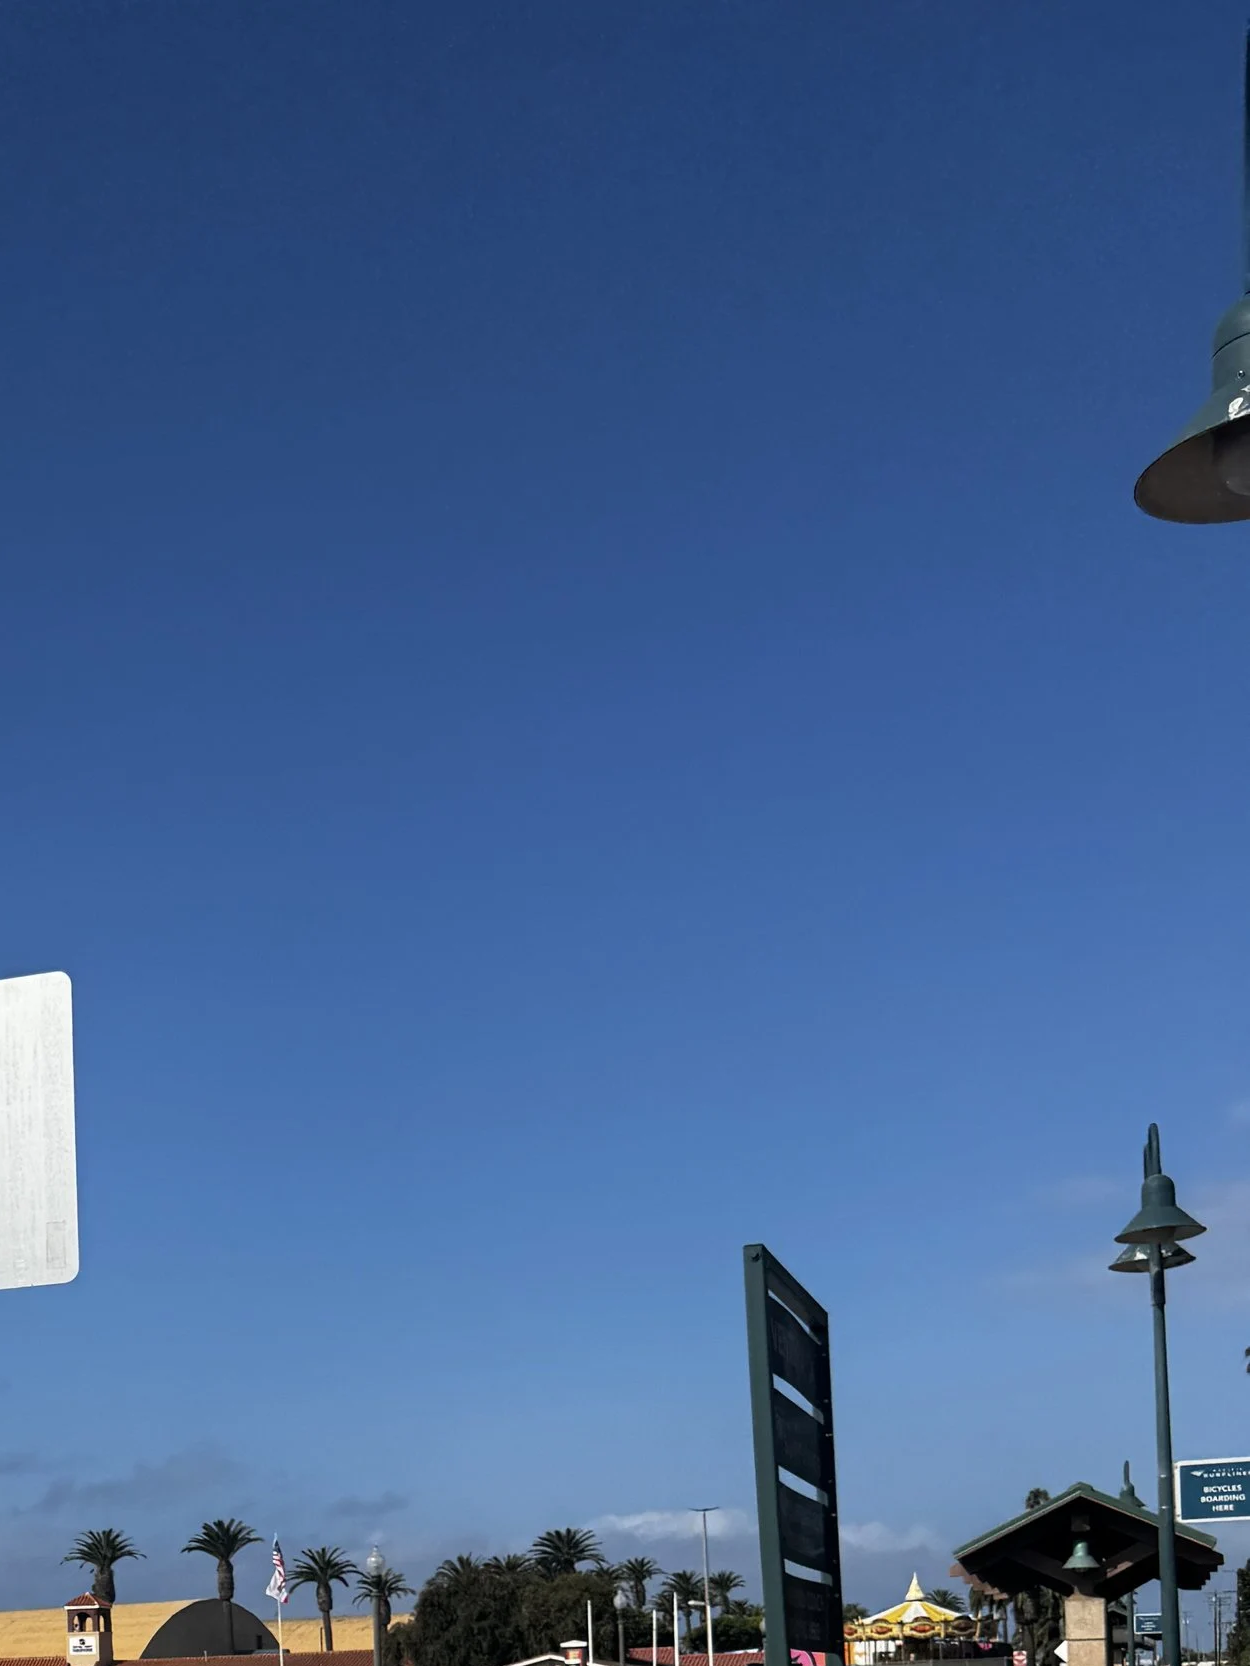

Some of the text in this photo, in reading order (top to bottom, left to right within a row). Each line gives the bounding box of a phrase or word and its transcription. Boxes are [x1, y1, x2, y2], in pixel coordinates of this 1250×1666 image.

[1203, 1484, 1242, 1493] BICYCLES
[1200, 1493, 1246, 1503] BOARDING
[1212, 1504, 1235, 1512] HERE
